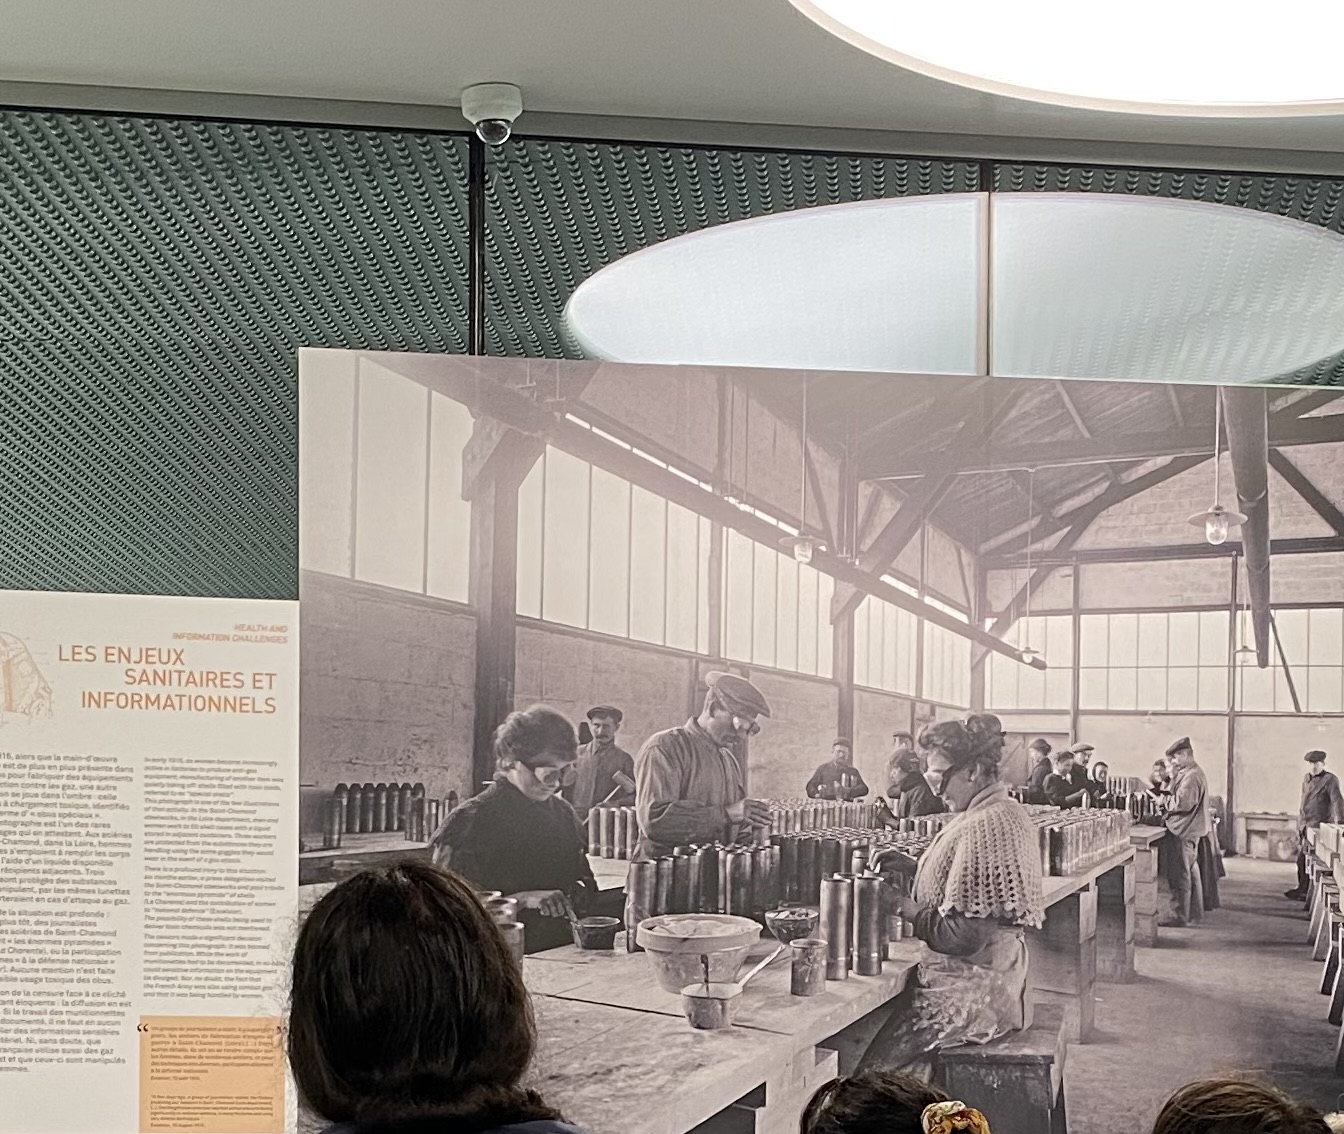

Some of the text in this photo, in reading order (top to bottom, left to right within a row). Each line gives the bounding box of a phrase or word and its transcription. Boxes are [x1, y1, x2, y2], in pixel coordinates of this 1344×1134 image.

[172, 632, 288, 644] INFORMATION CHALLENGES
[234, 623, 288, 633] HEALTH AND
[58, 644, 185, 666] LES ENJEUX
[124, 669, 277, 690] SANITAIRES ET
[81, 691, 277, 714] INFORMATIONNELS
